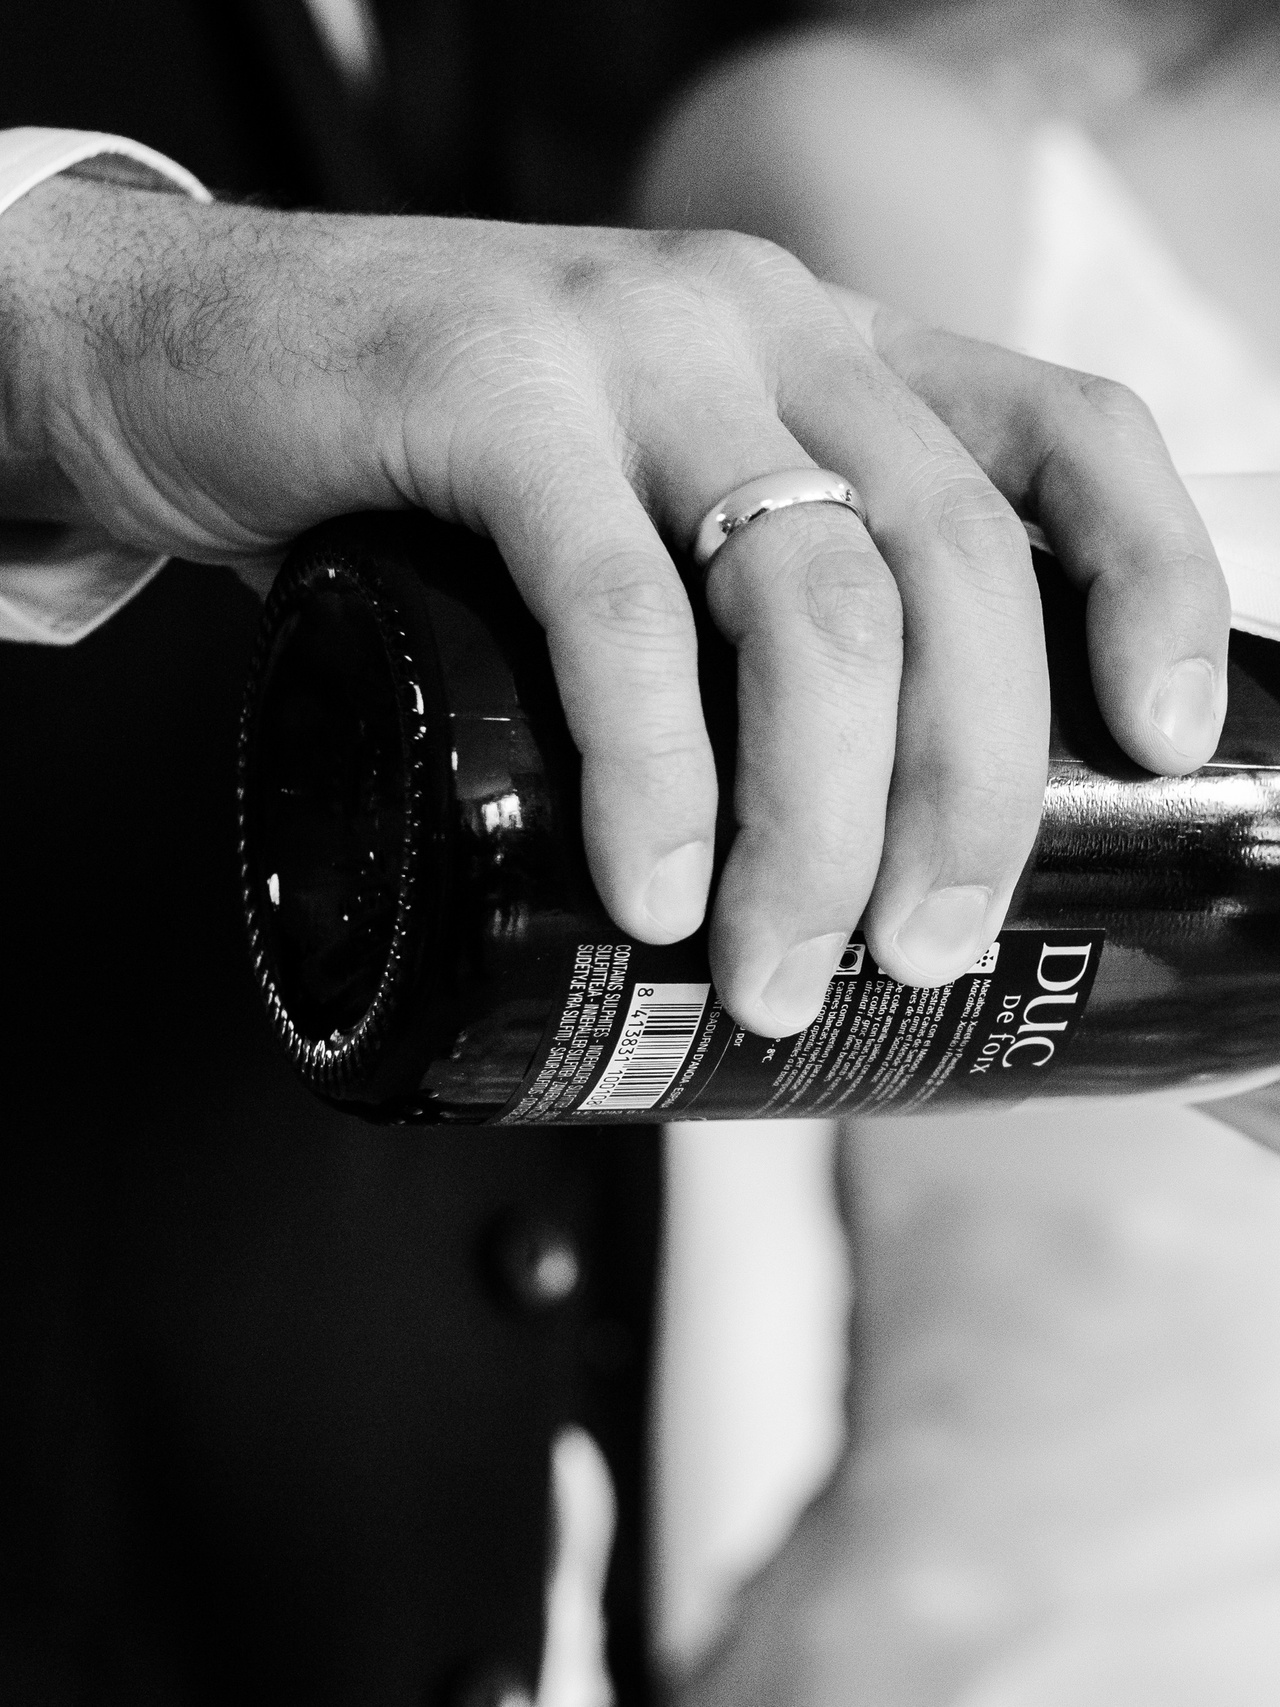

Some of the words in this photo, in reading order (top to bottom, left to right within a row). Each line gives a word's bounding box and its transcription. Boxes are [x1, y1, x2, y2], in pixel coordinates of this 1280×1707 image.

[606, 945, 632, 990] CONTAINS
[637, 987, 654, 997] 8
[823, 982, 836, 1003] Ideal
[831, 981, 845, 1009] carnes
[844, 981, 858, 1002] Ideal
[858, 981, 873, 1010] afruitat
[874, 980, 885, 993] De
[908, 987, 920, 1004] aves
[565, 992, 584, 1008] YRA
[712, 998, 723, 1010] NT
[867, 996, 879, 1018] color
[878, 981, 895, 1015] afrutado
[889, 994, 900, 1014] color
[916, 988, 930, 1014] aborat
[926, 988, 940, 1015] uestras
[961, 979, 982, 1018] Macabeu,
[970, 979, 992, 1019] Macabeo,
[1002, 942, 1092, 1068] DUC
[593, 993, 621, 1037] SULPHITES
[816, 1005, 828, 1023] com
[835, 1004, 849, 1027] como
[904, 1006, 914, 1017] de
[819, 1011, 838, 1040] blancas
[850, 1015, 862, 1033] amb
[859, 1019, 871, 1037] groc
[869, 1023, 880, 1037] con
[877, 1016, 894, 1042] amarillo
[898, 1018, 911, 1034] Sant
[909, 1016, 920, 1033] amb
[917, 1016, 931, 1037] cavas
[927, 1024, 938, 1038] con
[614, 1009, 648, 1062] 413831
[734, 1033, 745, 1047] por
[803, 1025, 820, 1052] aperitiu
[821, 1028, 840, 1058] aperitivo
[842, 1035, 856, 1050] fines
[861, 1038, 876, 1054] finas
[912, 1039, 922, 1047] de
[544, 1047, 567, 1069] SATUR
[572, 1045, 605, 1084] INDEHOLDER
[795, 1057, 805, 1068] per
[808, 1047, 822, 1062] rojas
[679, 1054, 704, 1083] D'ANOIA
[810, 1064, 822, 1077] para
[586, 1069, 624, 1105] 100108
